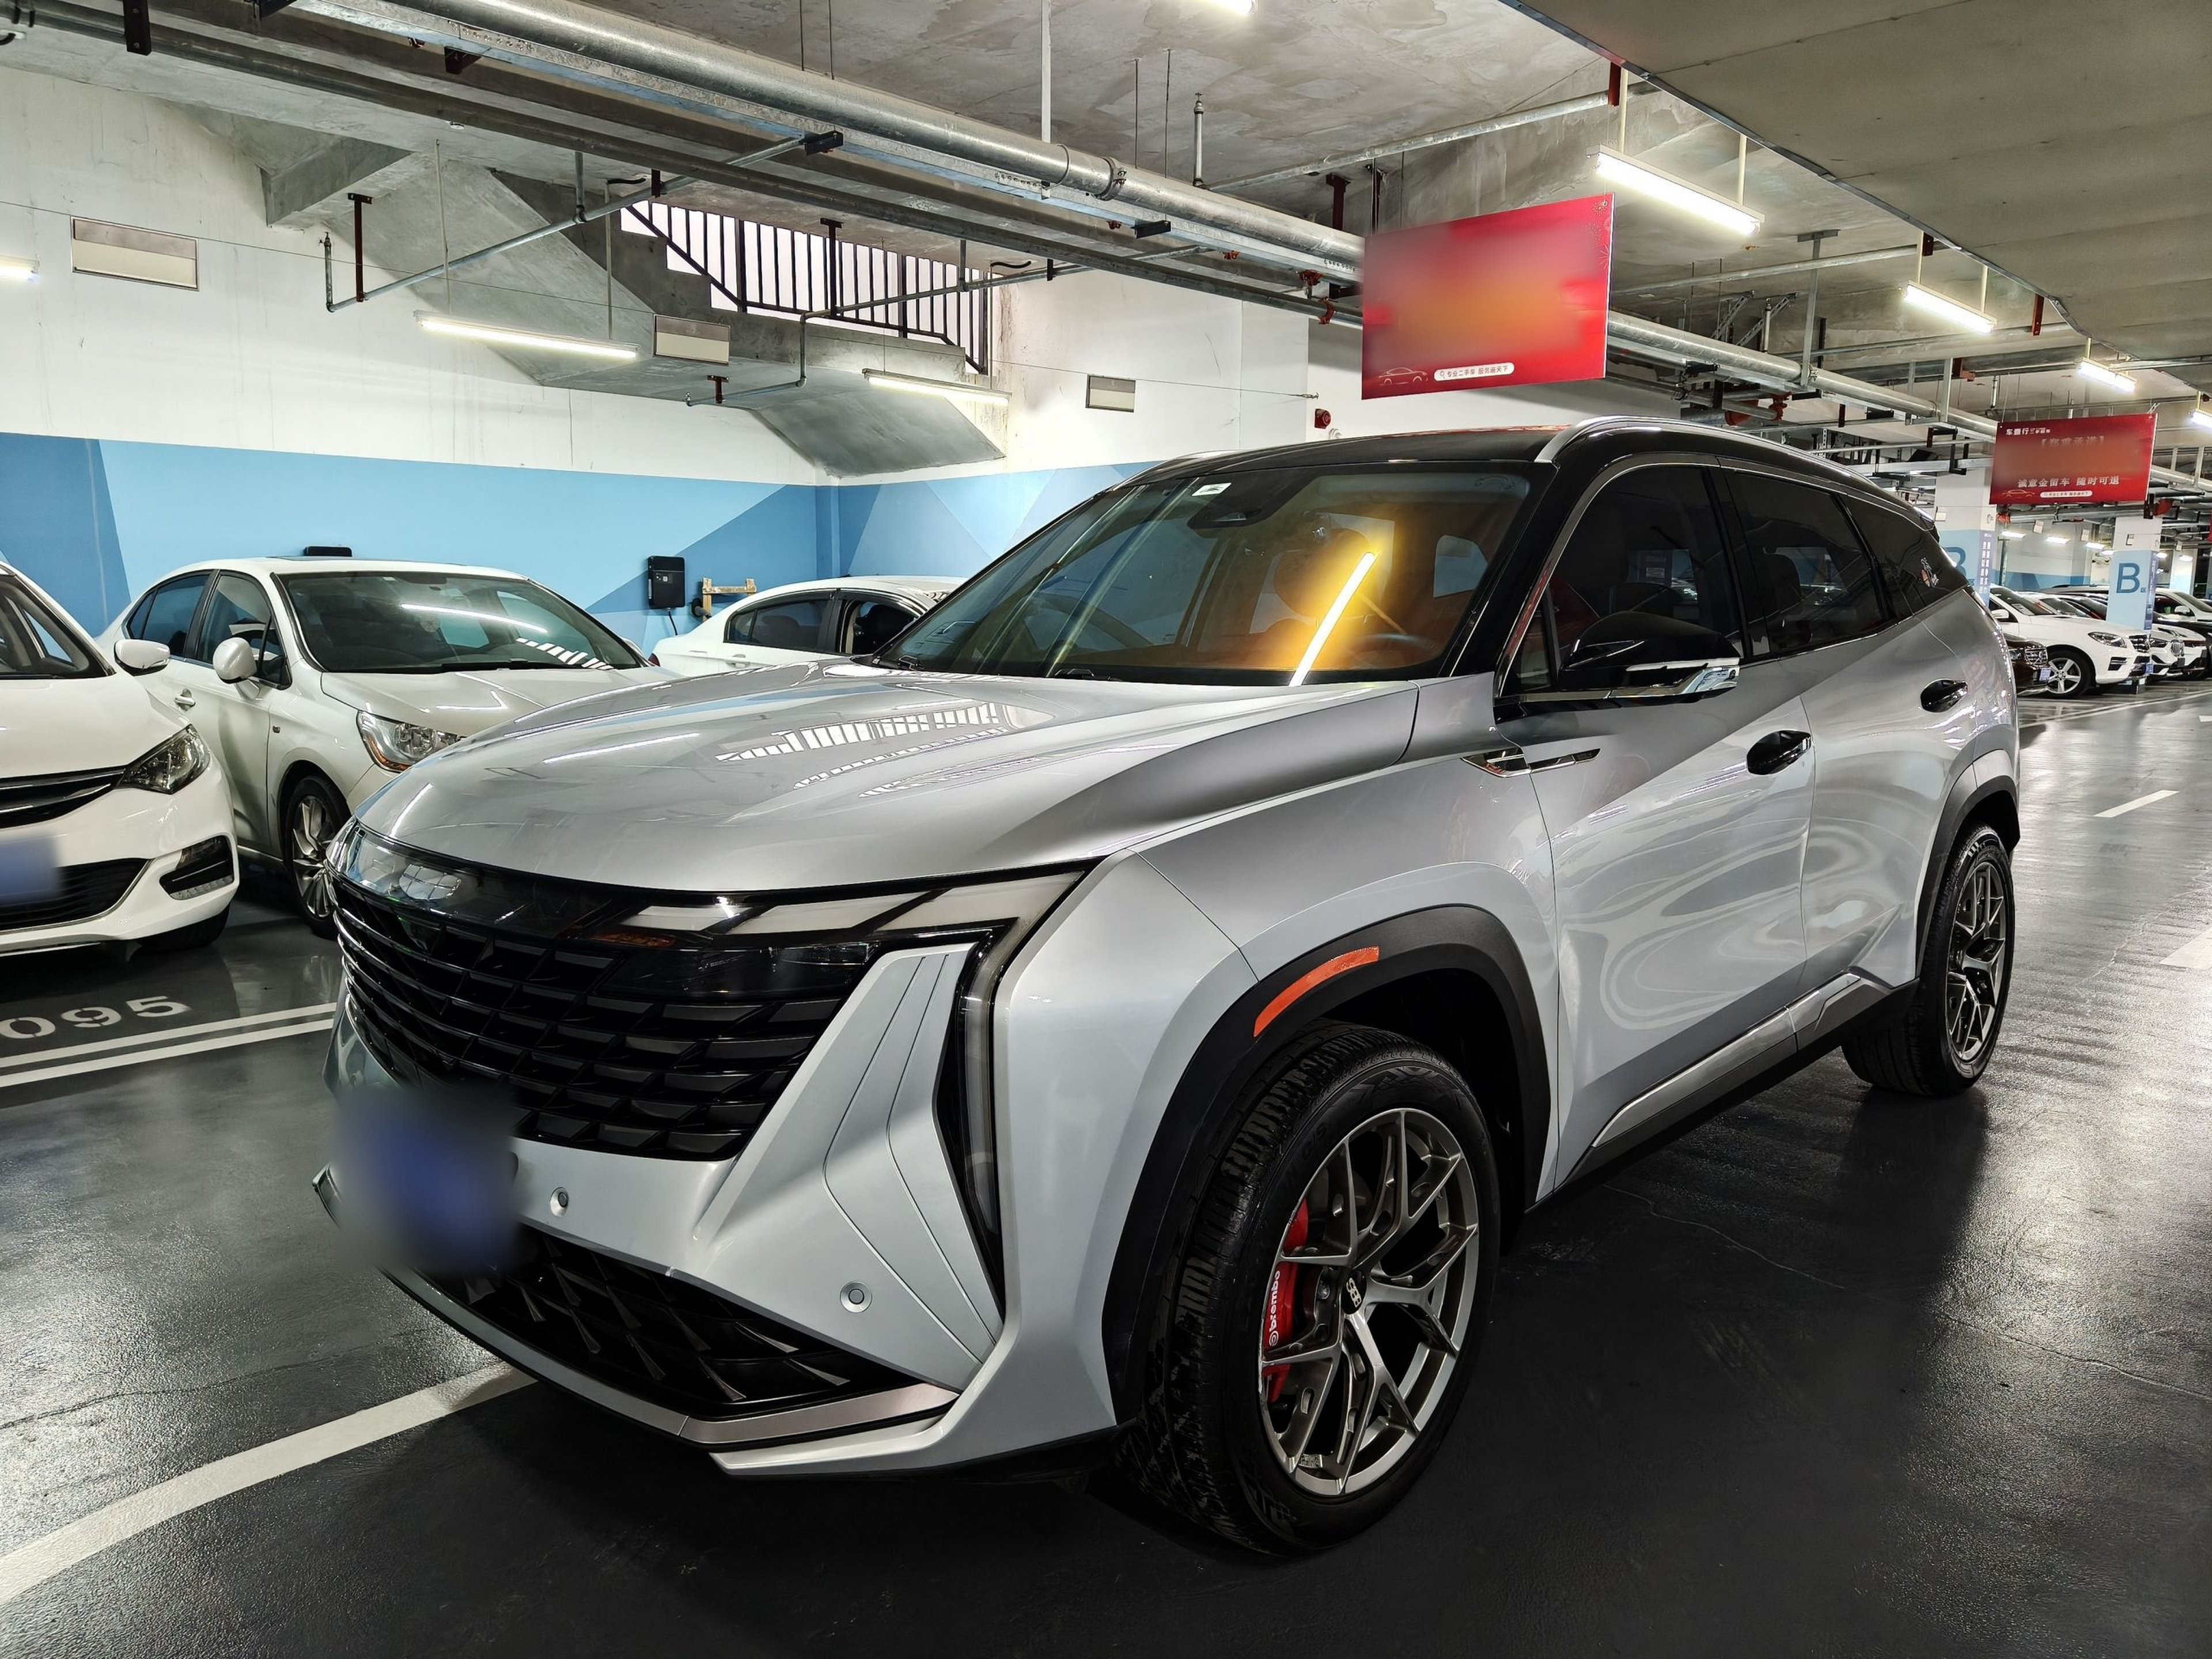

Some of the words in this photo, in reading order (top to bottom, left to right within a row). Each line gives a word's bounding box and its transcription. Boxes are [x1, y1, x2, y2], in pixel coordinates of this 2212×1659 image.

[2018, 478, 2070, 488] 诚意金留车
[2076, 476, 2120, 487] 随时可退
[0, 995, 192, 1039] 095
[1269, 1270, 1281, 1333] brembo
